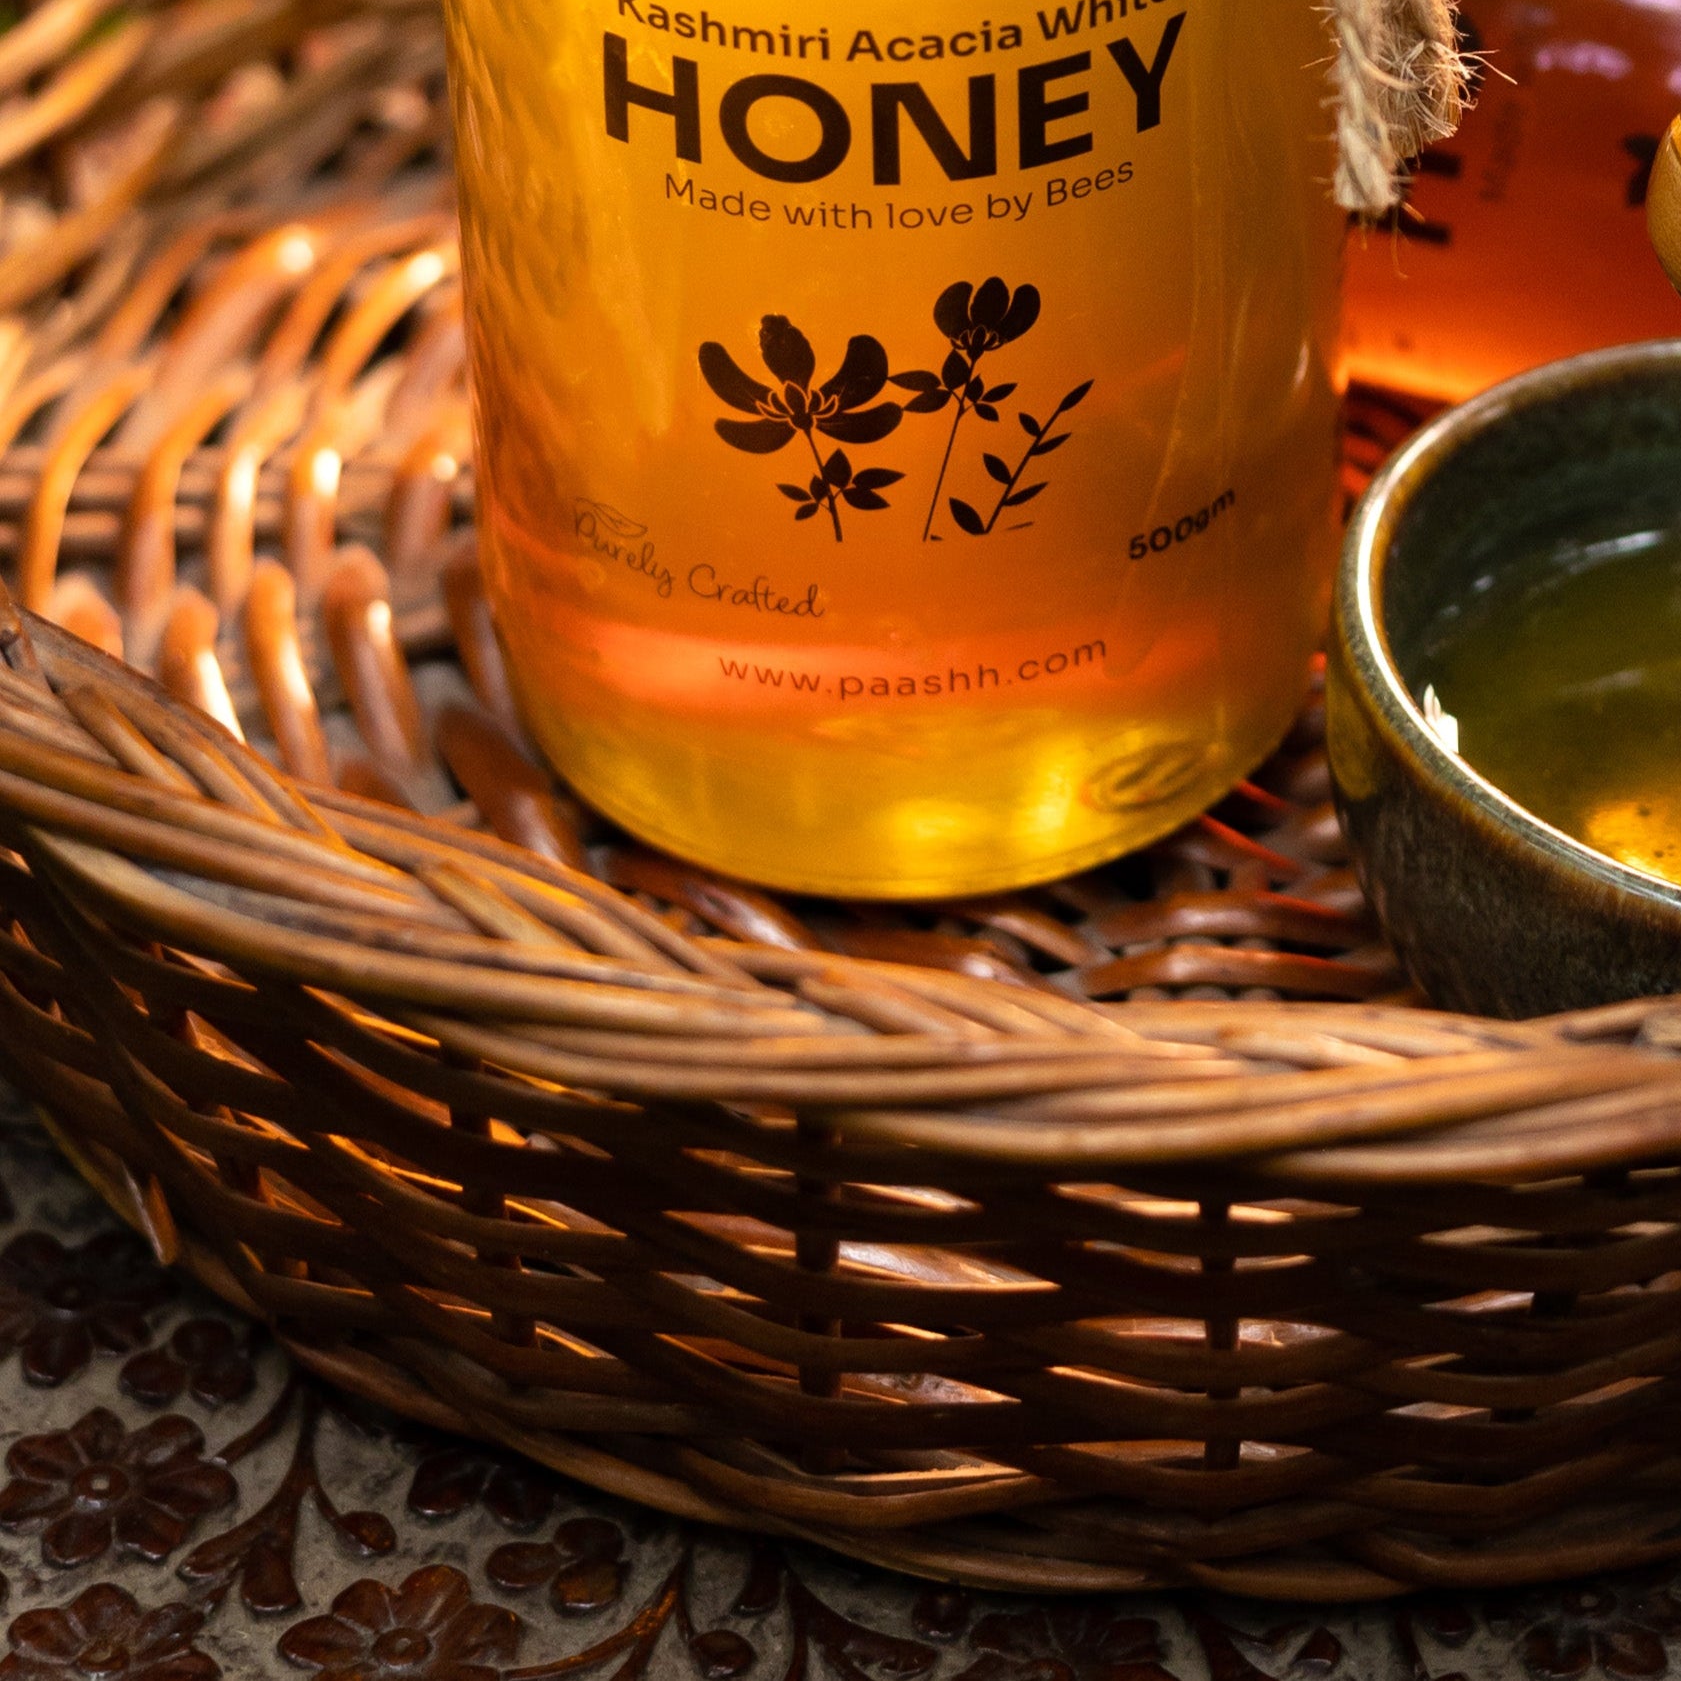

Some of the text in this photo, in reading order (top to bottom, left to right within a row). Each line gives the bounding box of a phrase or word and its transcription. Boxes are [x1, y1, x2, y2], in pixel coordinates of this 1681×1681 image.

[846, 20, 1023, 62] Acacia
[603, 11, 1187, 186] HONEY
[665, 160, 1134, 229] Made with love by Bees
[574, 497, 824, 617] Purely Crafted
[718, 639, 1107, 700] www.paashh.com
